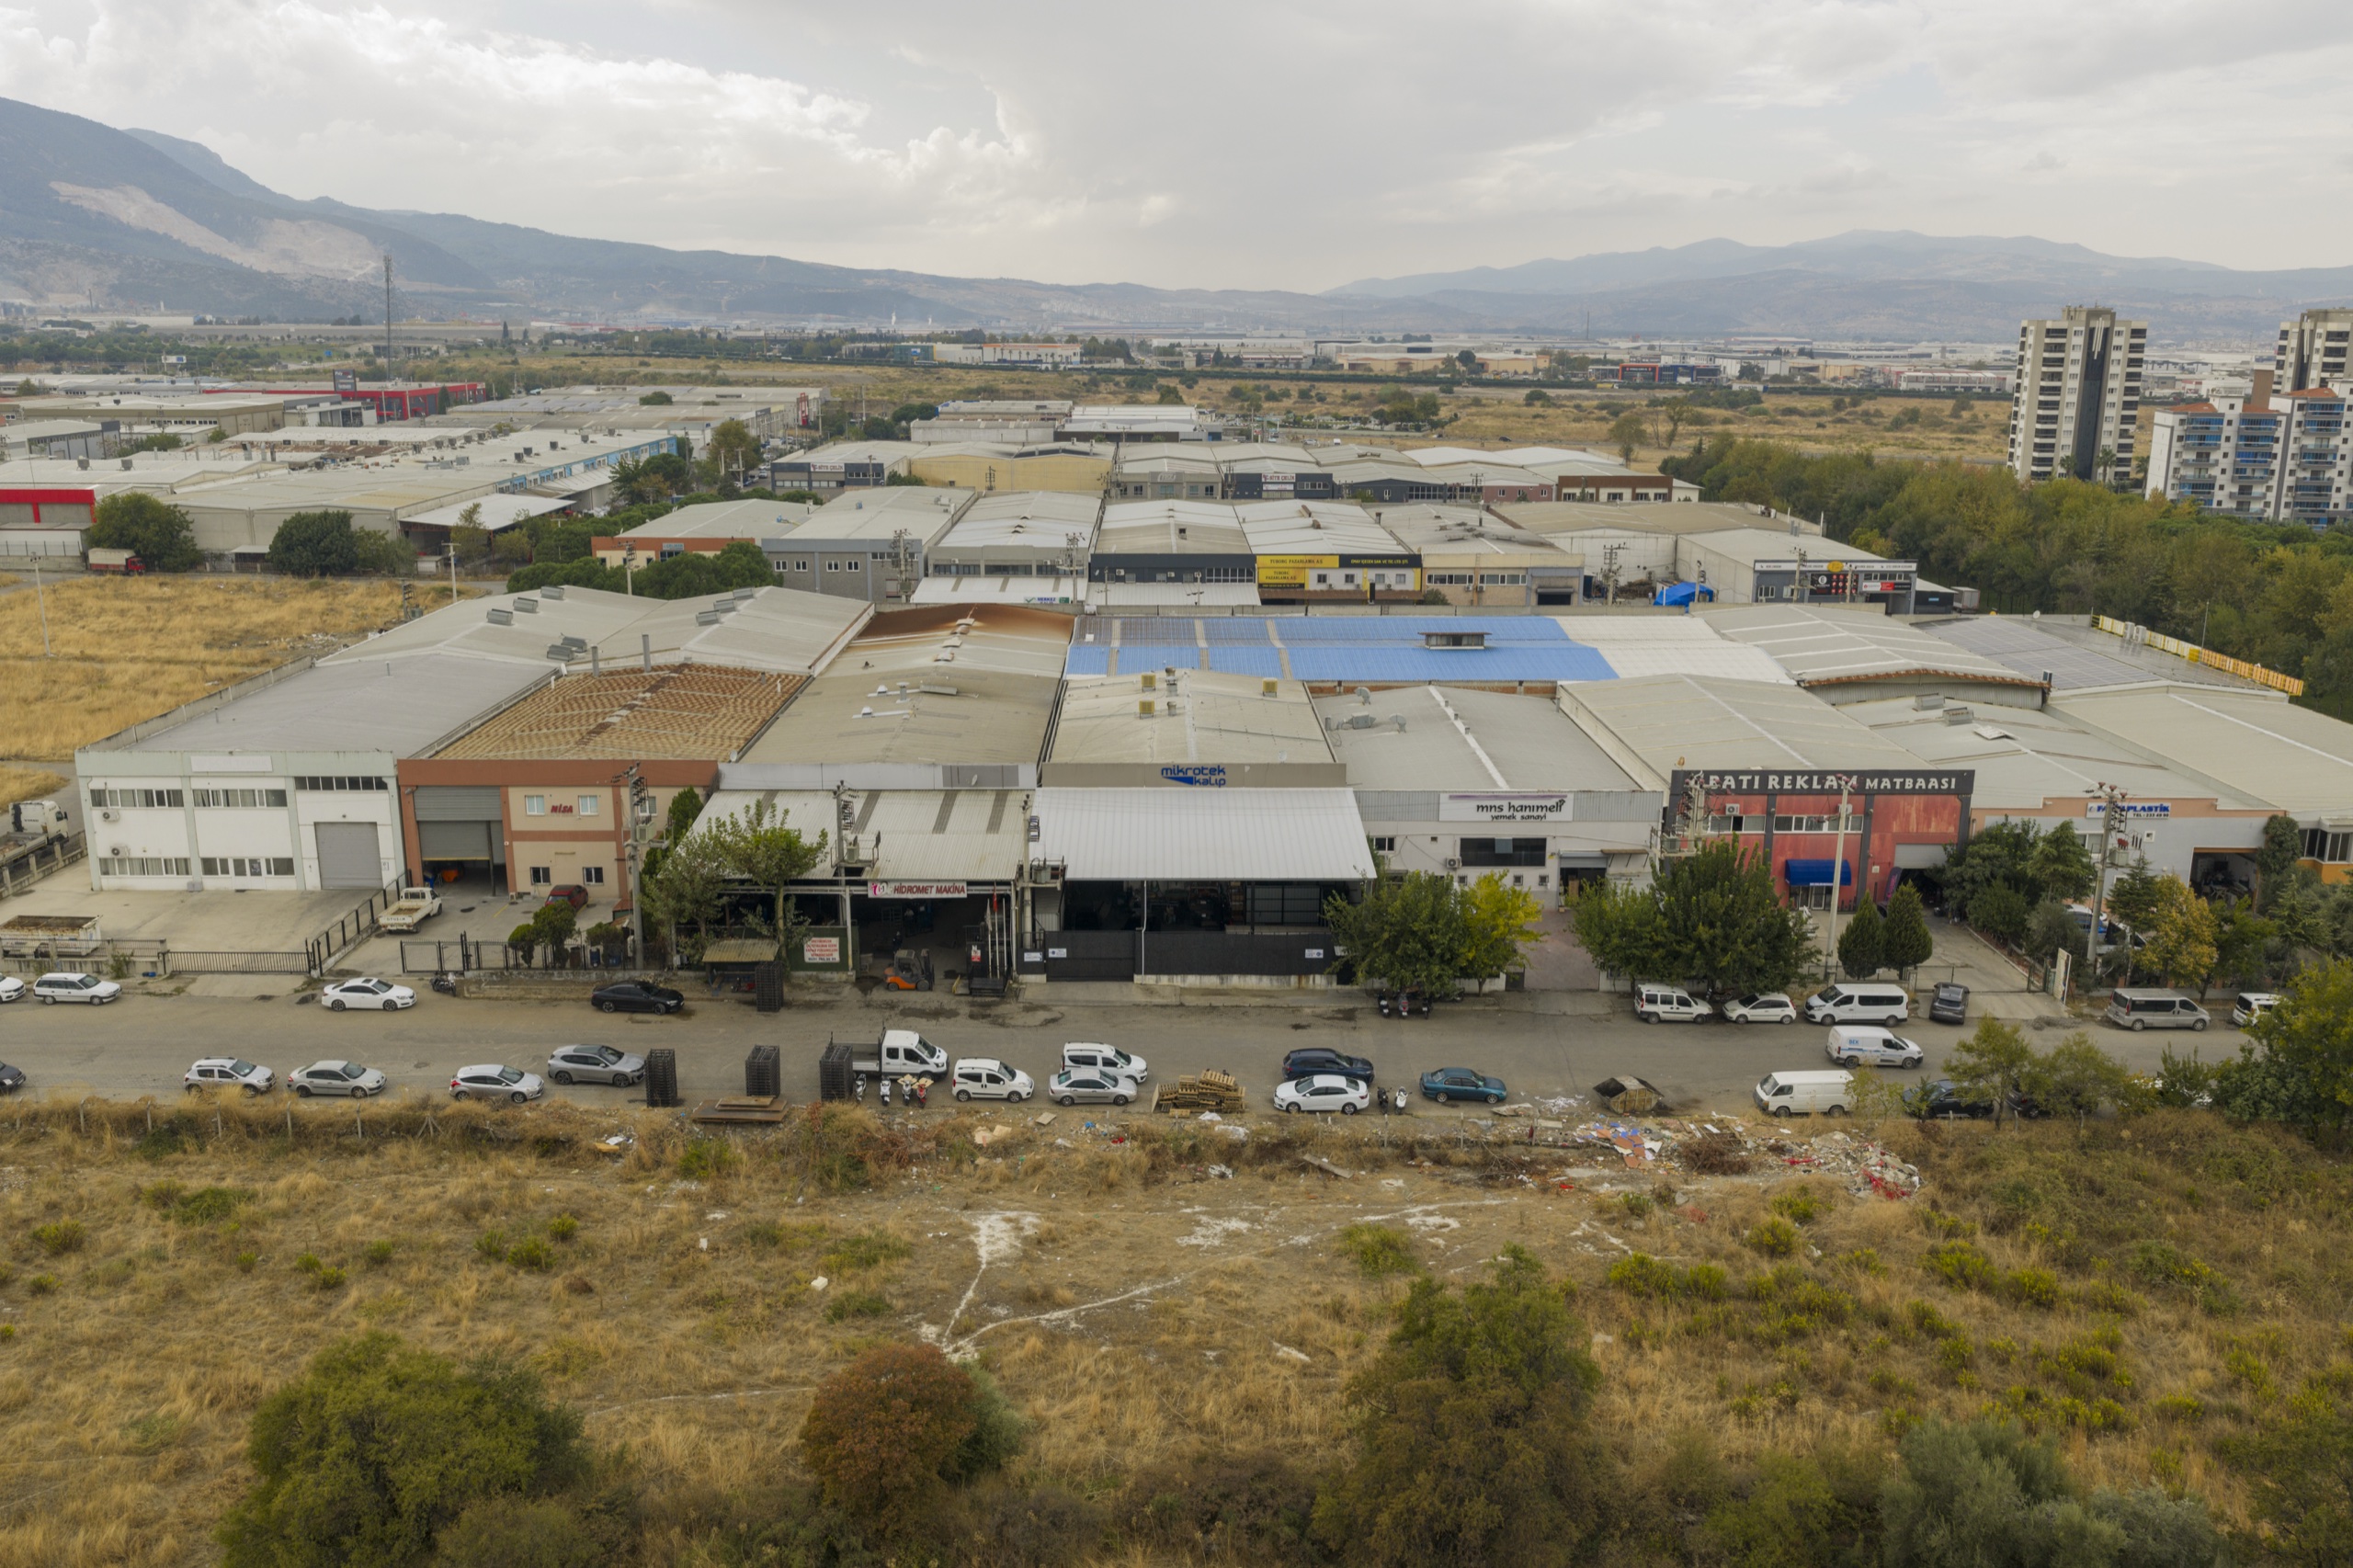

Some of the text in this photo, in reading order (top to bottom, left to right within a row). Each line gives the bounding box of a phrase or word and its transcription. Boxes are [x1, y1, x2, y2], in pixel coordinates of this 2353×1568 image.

[1161, 765, 1226, 776] mikrotek
[1710, 775, 1956, 790] BATI REKLAM MATBAASI
[1476, 803, 1505, 812] mns
[1491, 812, 1547, 821] yemek sanayi
[893, 882, 966, 894] HİDROMET MAKİNA
